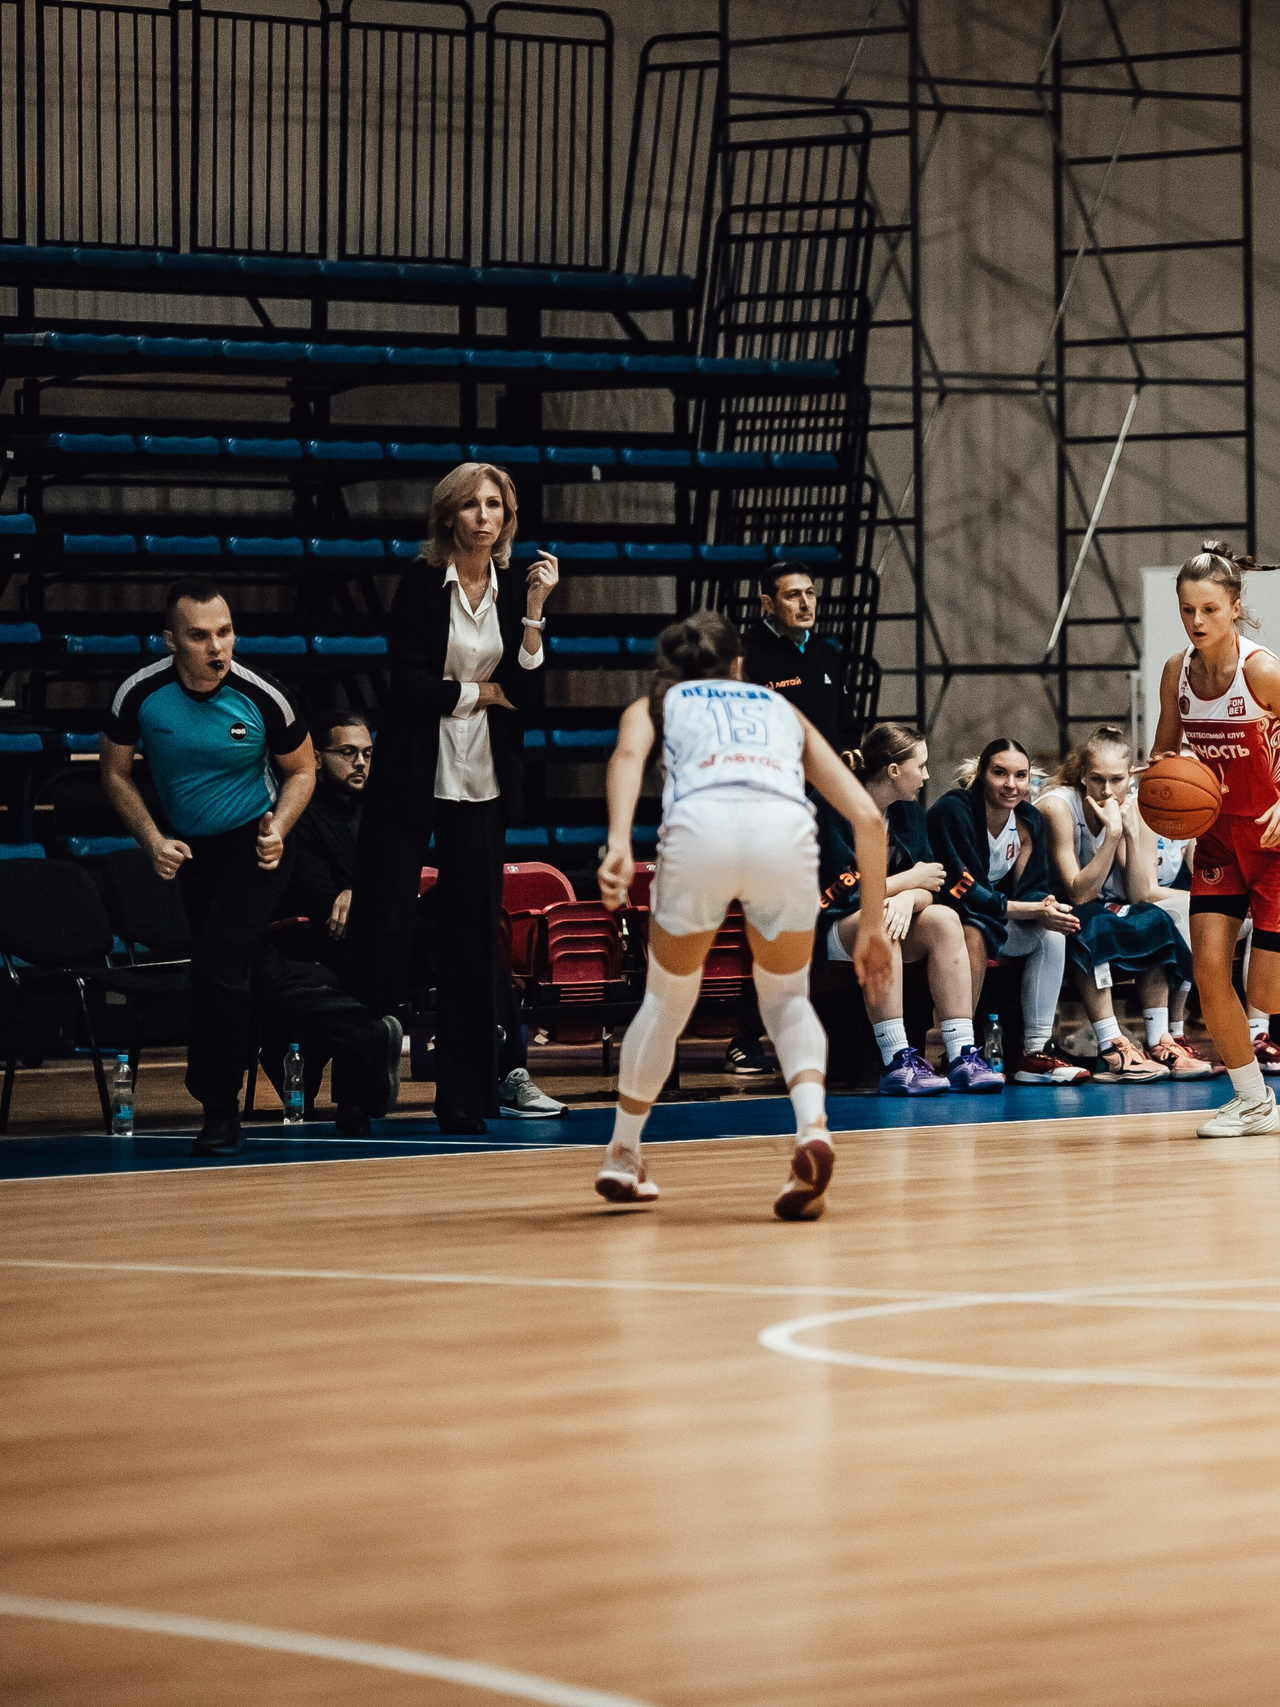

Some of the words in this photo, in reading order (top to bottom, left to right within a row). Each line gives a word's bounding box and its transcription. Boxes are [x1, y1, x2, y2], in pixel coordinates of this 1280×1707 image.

[1229, 706, 1243, 714] BET
[707, 701, 767, 745] 15
[1186, 731, 1225, 739] СКЕТБОЛЬНЫЙ
[1227, 731, 1246, 739] КЛУБ
